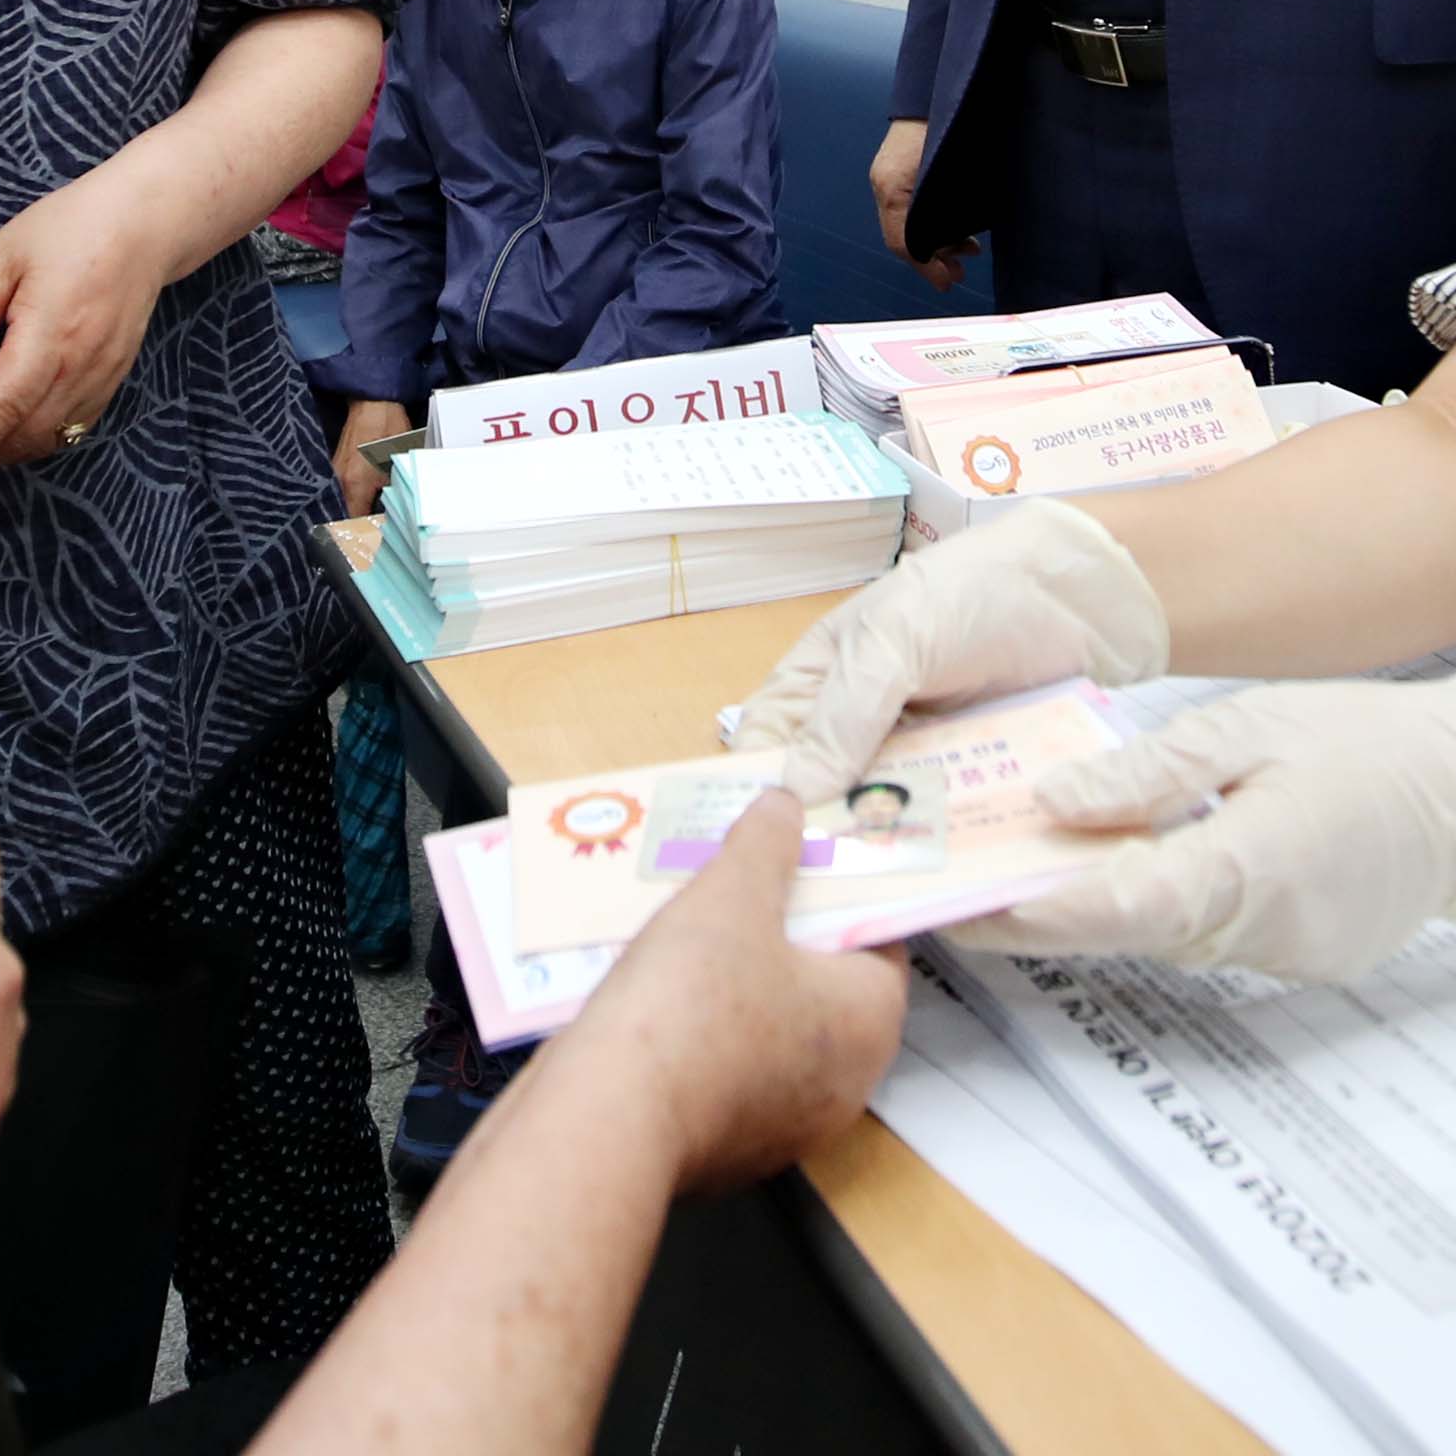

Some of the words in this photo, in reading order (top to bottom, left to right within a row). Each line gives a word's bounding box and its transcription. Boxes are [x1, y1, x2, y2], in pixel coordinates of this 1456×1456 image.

[1032, 430, 1077, 452] 2020년
[1078, 422, 1114, 442] 어르신
[1114, 415, 1140, 431] 목욕
[1141, 411, 1153, 426] 및
[1154, 403, 1189, 423] 이미용
[1190, 397, 1214, 414] 전용
[1100, 419, 1228, 468] 동구사랑상품권
